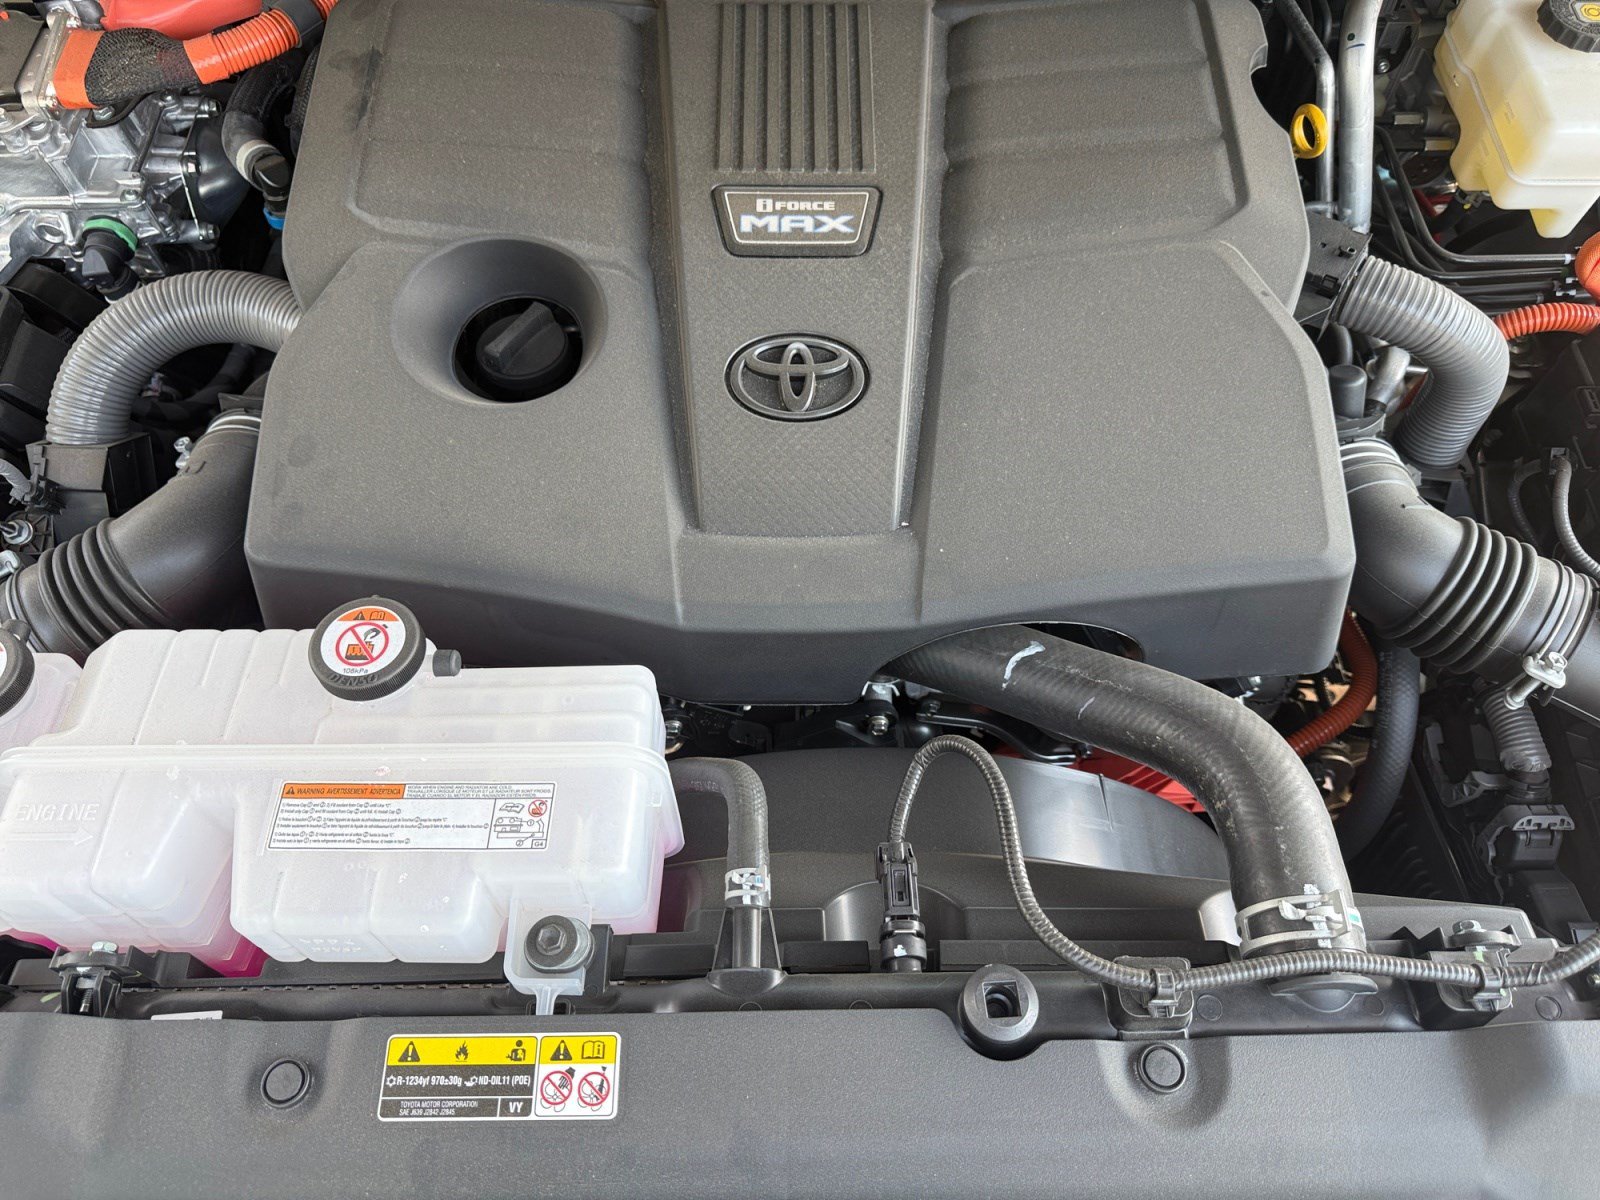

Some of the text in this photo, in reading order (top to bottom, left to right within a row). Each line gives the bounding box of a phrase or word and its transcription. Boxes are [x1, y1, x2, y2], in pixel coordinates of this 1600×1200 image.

[775, 201, 835, 211] FORCE
[740, 214, 855, 233] MAX
[297, 787, 401, 795] WARNING AVERTISSEMENT ADVERTENCIA
[16, 803, 100, 821] ENGINE
[396, 1074, 531, 1087] R-1234yf 970±30g ND-OIL11 (POE)
[401, 1100, 478, 1109] TOYOTA MOTOR CORPORATION
[509, 1101, 523, 1113] VY
[399, 1108, 455, 1116] SAE J639 J2842 J2845
